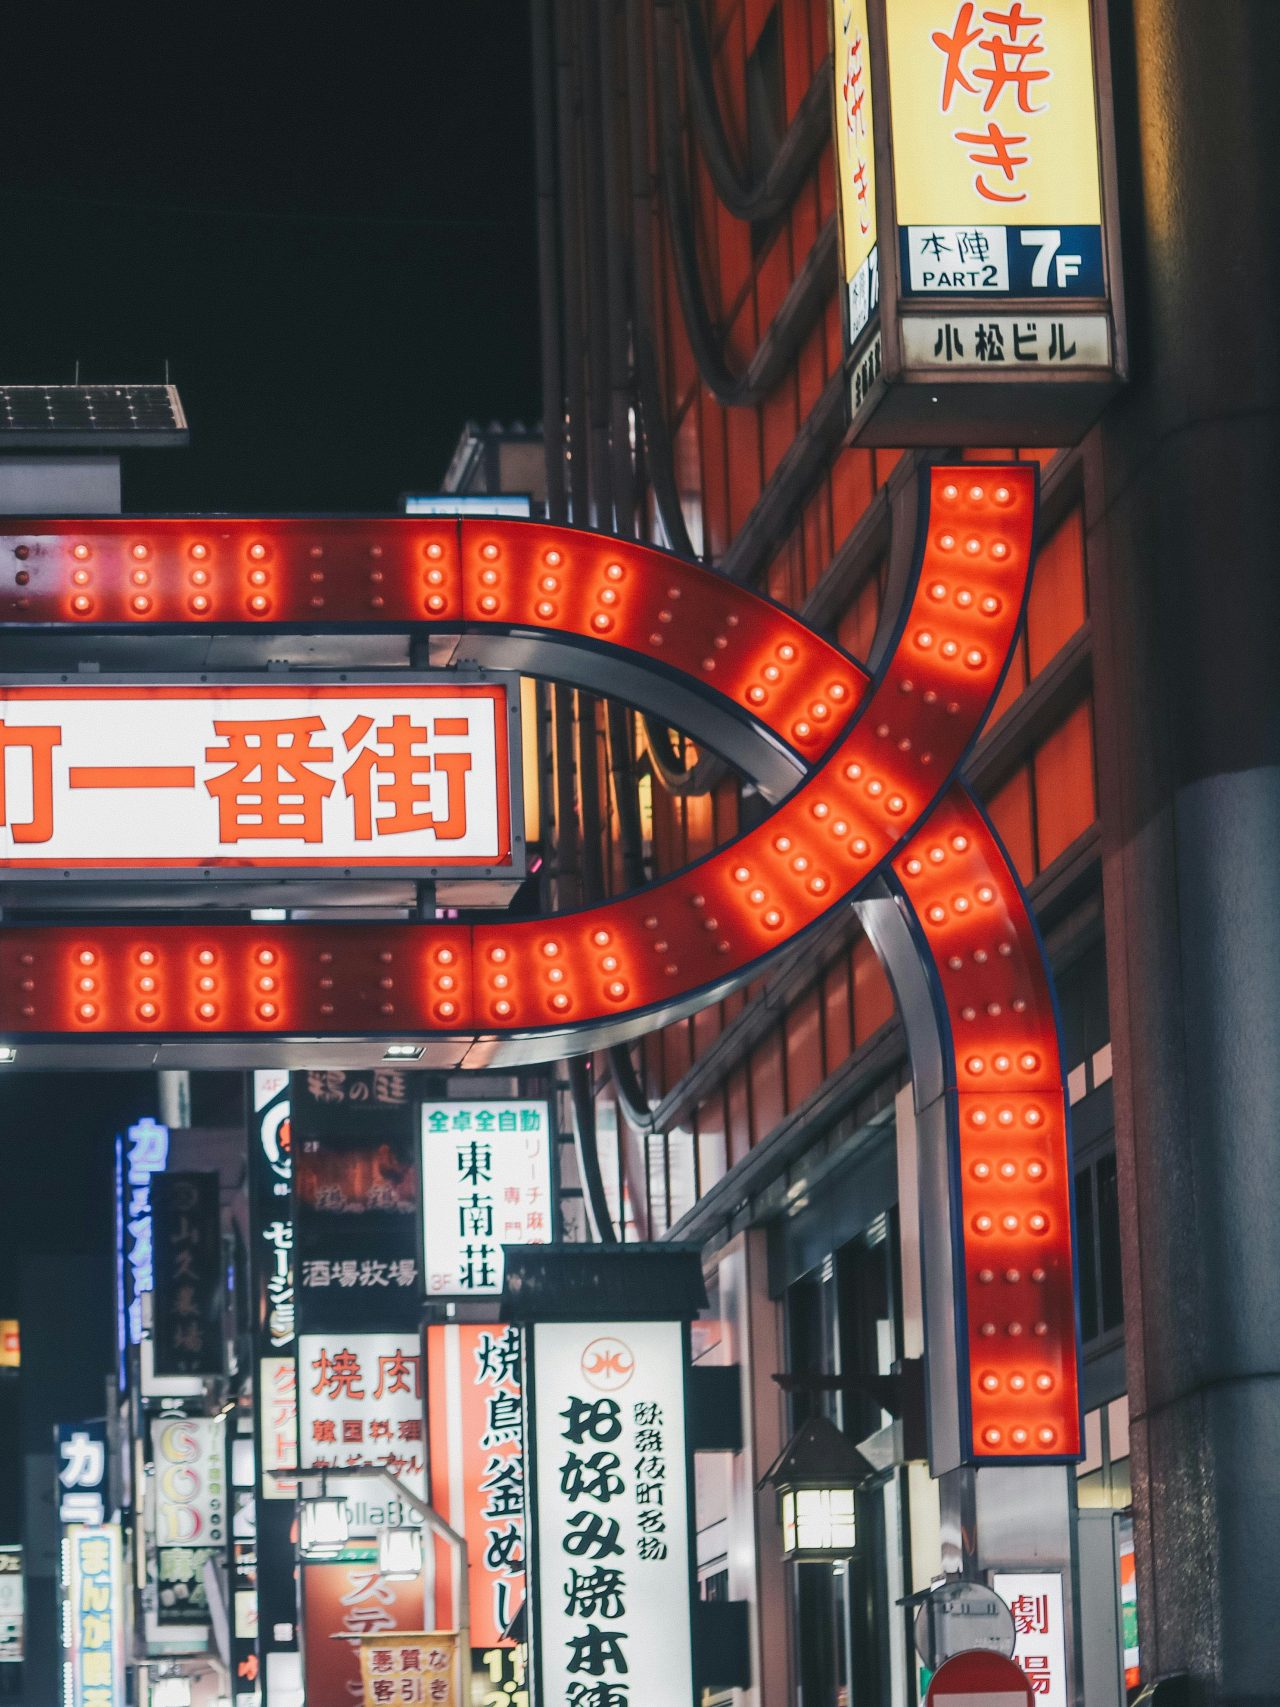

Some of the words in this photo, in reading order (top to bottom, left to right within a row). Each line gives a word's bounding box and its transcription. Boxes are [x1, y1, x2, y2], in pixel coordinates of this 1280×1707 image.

[931, 2, 1052, 204] 焼き
[920, 231, 990, 264] 本陣
[1020, 230, 1081, 289] 7F
[922, 265, 999, 288] PART2
[934, 323, 1077, 362] 小松ビル
[428, 1110, 542, 1133] 全卓全自動
[525, 1139, 544, 1244] リーチ麻
[456, 1141, 496, 1289] 東南荘
[311, 1347, 423, 1400] 焼肉
[312, 1418, 423, 1444] 韓国料理
[474, 1327, 527, 1638] 焼鳥釜めし
[372, 1649, 450, 1673] 悪質な
[372, 1678, 450, 1703] 客引き
